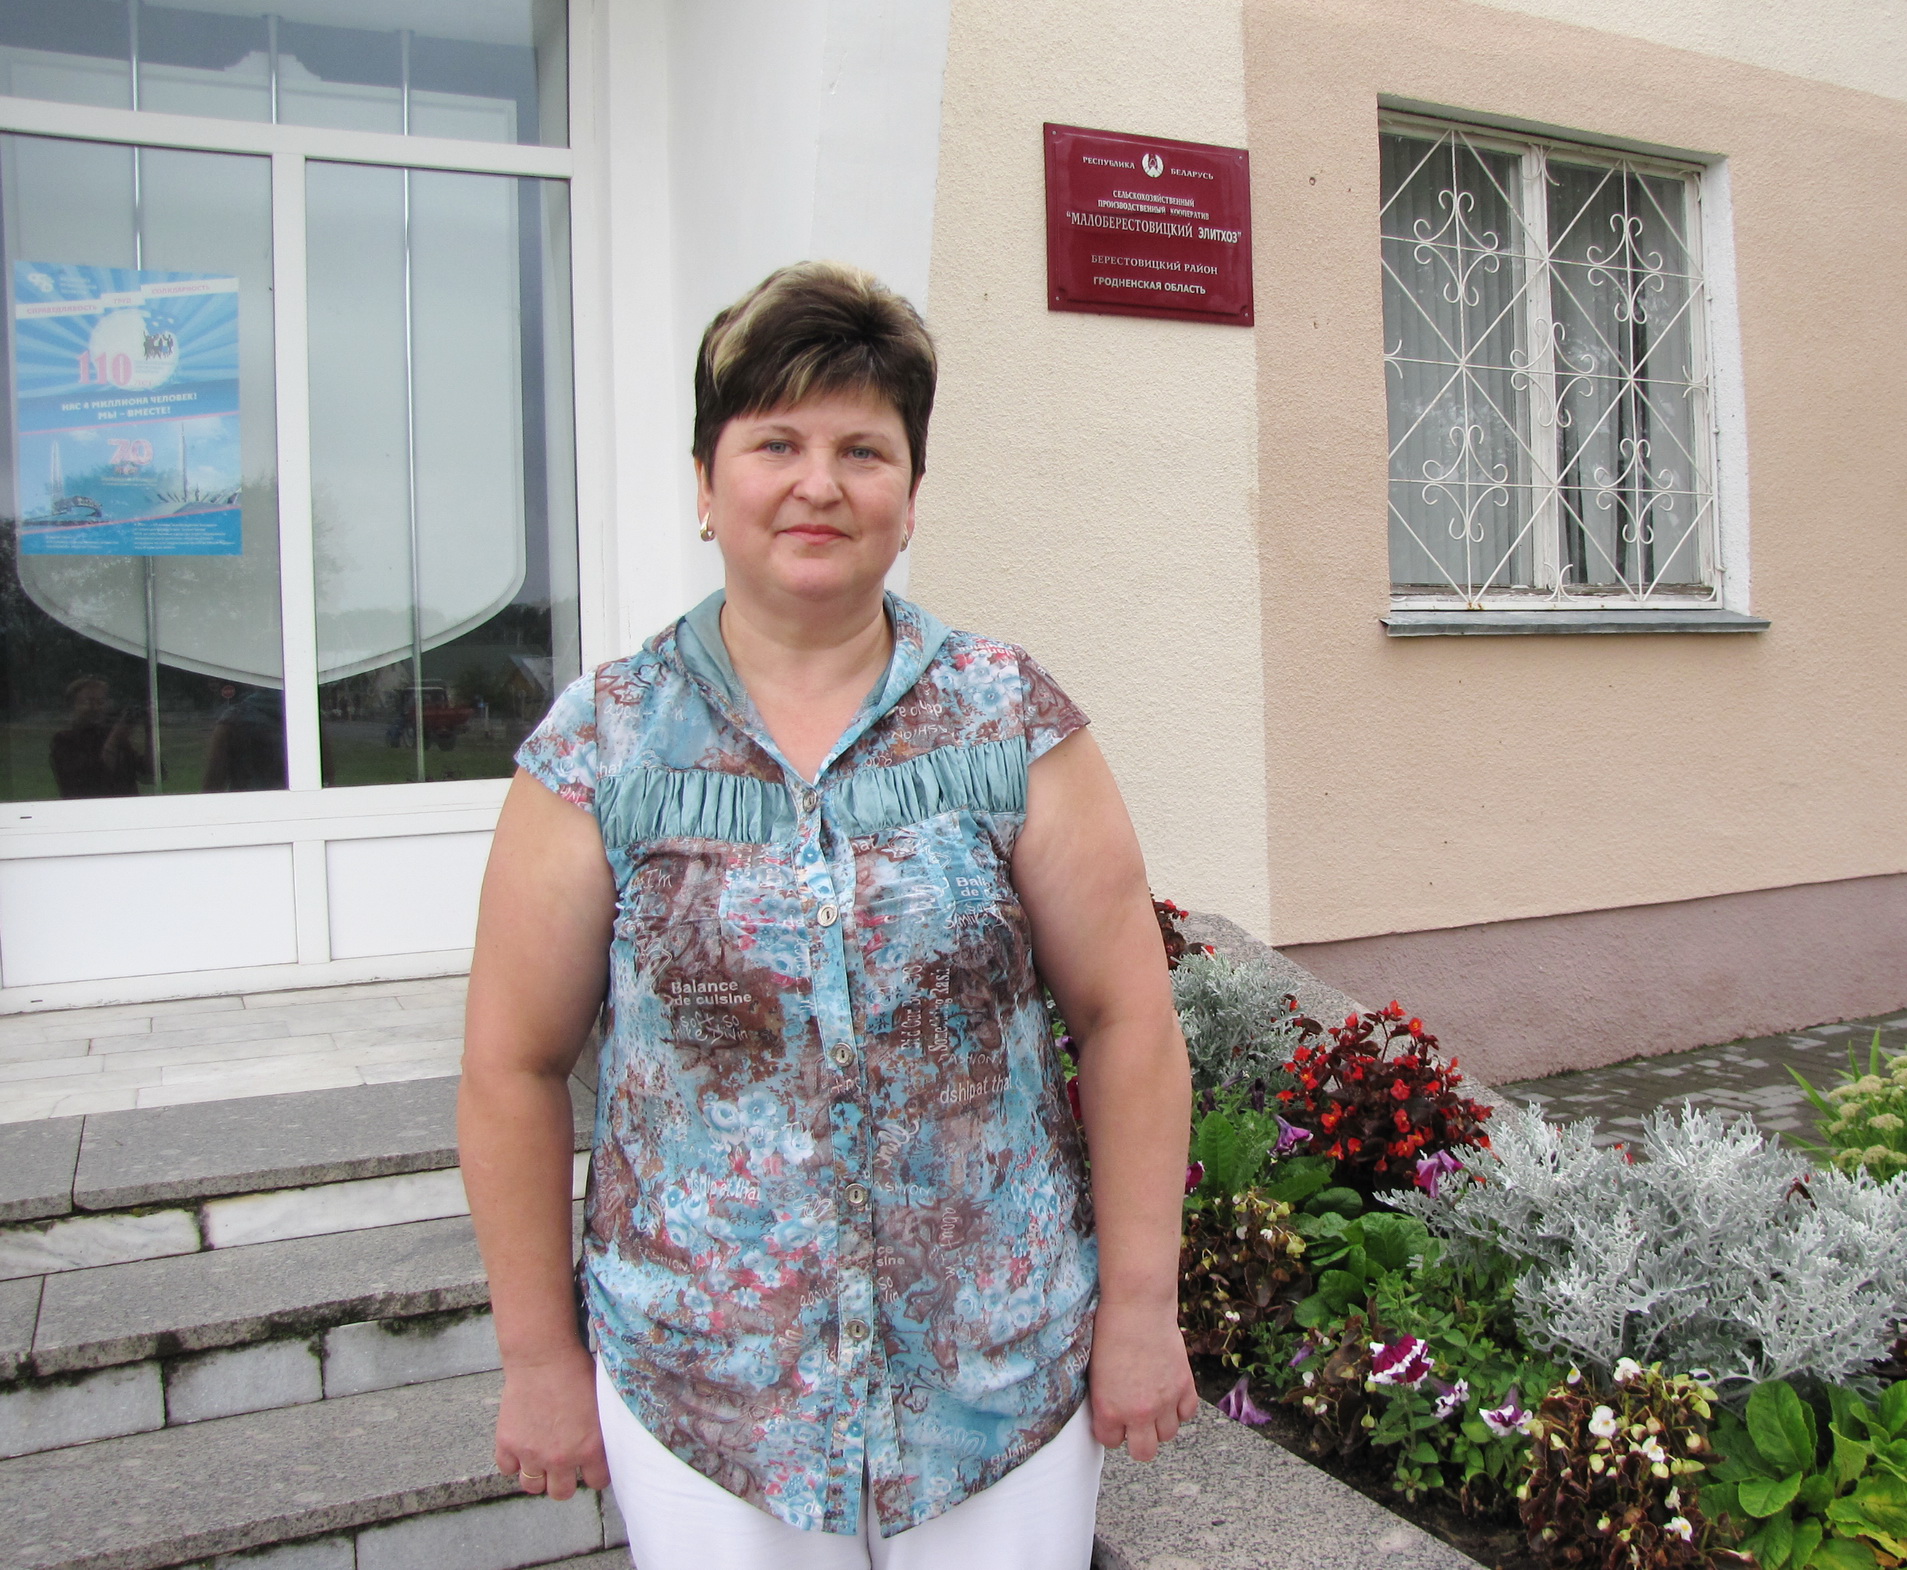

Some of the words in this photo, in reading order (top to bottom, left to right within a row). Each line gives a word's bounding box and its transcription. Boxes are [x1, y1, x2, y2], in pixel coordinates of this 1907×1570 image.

[1082, 156, 1136, 170] РЕСПУБЛИКА
[1170, 168, 1214, 180] БЕЛАРУСЬ
[1112, 189, 1195, 208] СЕЛЬСКОХОЗЯЙСТВЕННЫЙ
[1097, 199, 1166, 215] ПРОИЗВОДСТВЕННЫЙ
[1169, 207, 1210, 221] КООПЕРАТИВ
[1091, 254, 1181, 272] БЕРЕСТОВИЦКИЙ
[1184, 262, 1218, 275] РАЙОН
[1093, 276, 1162, 291] ГРОДНЕНСКАЯ
[1164, 282, 1206, 295] ОБЛАСТЬ
[77, 351, 133, 386] 110
[62, 402, 81, 411] НАС
[92, 397, 149, 409] МИЛЛИОНА
[150, 393, 197, 405] ЧЕЛОВЕК!
[98, 411, 117, 420] МЫ
[127, 406, 171, 417] ВМЕСТЕ!
[107, 438, 153, 465] 70
[671, 979, 739, 995] Balance
[674, 995, 691, 1006] de
